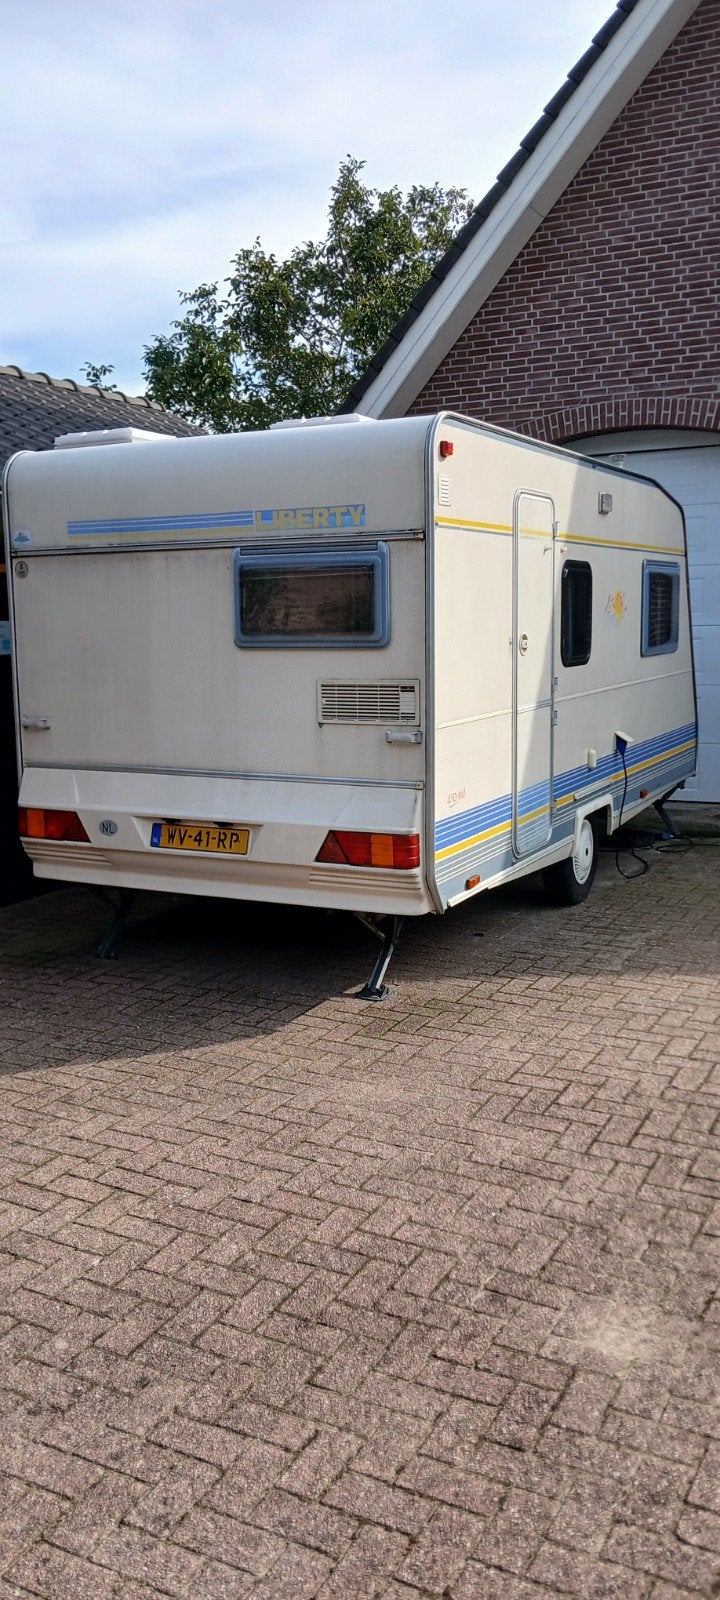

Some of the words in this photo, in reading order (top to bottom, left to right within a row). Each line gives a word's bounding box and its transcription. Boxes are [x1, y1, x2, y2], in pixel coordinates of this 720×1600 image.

[255, 504, 365, 531] LIBERTY
[101, 822, 115, 834] NL
[167, 827, 240, 849] WV-41-RP
